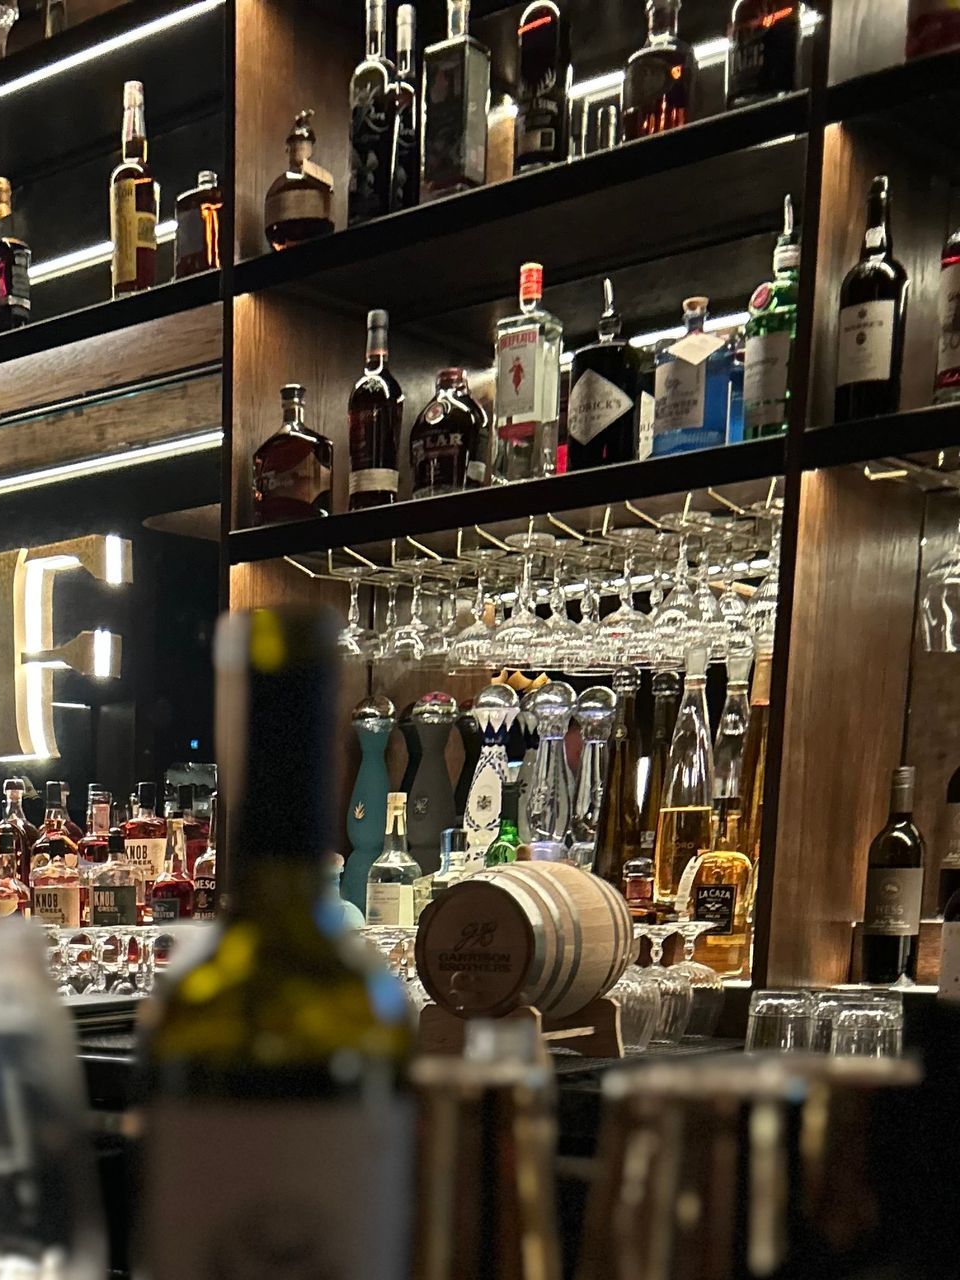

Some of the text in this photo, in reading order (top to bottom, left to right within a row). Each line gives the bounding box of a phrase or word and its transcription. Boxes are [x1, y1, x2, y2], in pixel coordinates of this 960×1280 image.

[500, 330, 538, 349] BEEFEATER
[424, 432, 464, 449] LAR
[125, 845, 148, 860] KNOB
[35, 892, 58, 908] KNOB
[94, 891, 115, 906] KNOB
[698, 889, 731, 900] LA CAZA
[438, 952, 511, 963] GARRISON
[438, 963, 513, 973] BROTHERS
